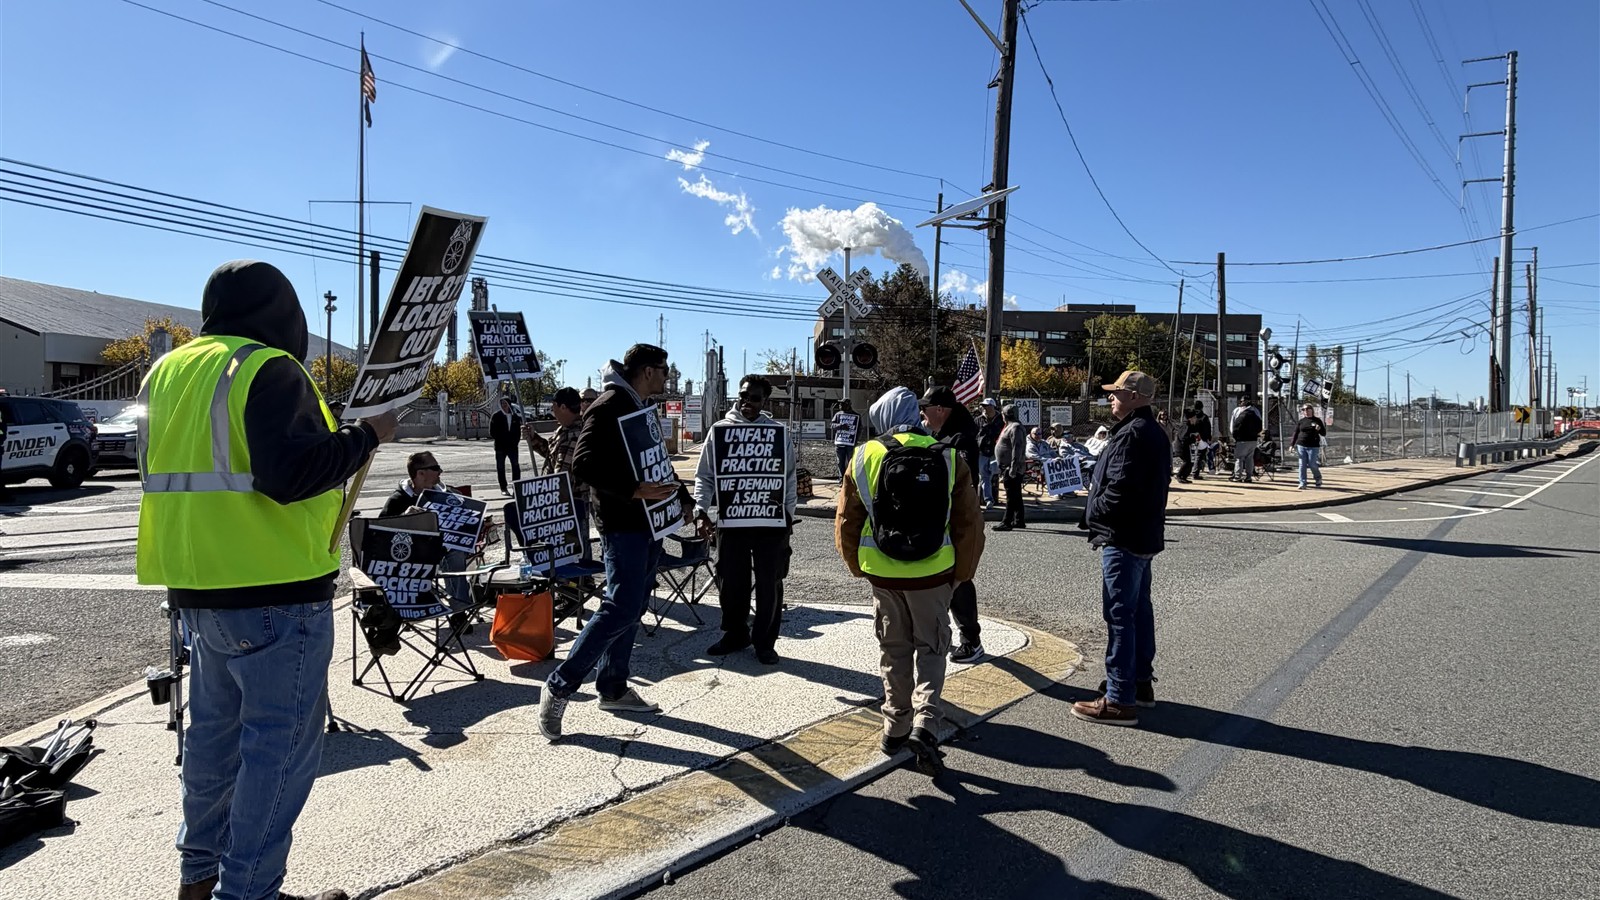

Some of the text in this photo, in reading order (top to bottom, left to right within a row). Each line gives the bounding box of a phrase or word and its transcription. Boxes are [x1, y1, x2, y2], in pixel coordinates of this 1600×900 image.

[401, 275, 443, 303] IBT
[399, 328, 439, 359] OUT
[355, 375, 384, 403] by
[1016, 400, 1037, 408] GATE
[1024, 409, 1030, 423] 1
[724, 428, 776, 443] UNFAIR
[5, 435, 57, 453] INDEN
[728, 443, 773, 457] LABOR
[9, 448, 45, 460] POLICE
[640, 444, 660, 469] IBT
[720, 459, 782, 473] PRACTICE
[1047, 457, 1076, 474] HONK
[1055, 472, 1065, 481] YOU
[1065, 470, 1078, 479] HATE
[522, 477, 560, 497] UNFAIR
[720, 478, 782, 492] WE DEMAND
[526, 491, 560, 510] LABOR
[732, 491, 771, 504] A SAFE
[422, 501, 481, 517] IBT 877
[523, 502, 569, 525] PRACTICE
[726, 504, 778, 518] CONTRACT
[437, 512, 479, 525] CKED
[439, 520, 465, 531] UT
[653, 510, 665, 528] by
[526, 519, 575, 541] WE DEMAND
[460, 536, 474, 546] 66
[534, 542, 576, 564] CONRACT
[367, 560, 434, 579] IBT 877
[369, 575, 433, 593] OCKED
[386, 590, 418, 604] OUT
[399, 605, 443, 619] illips 66
